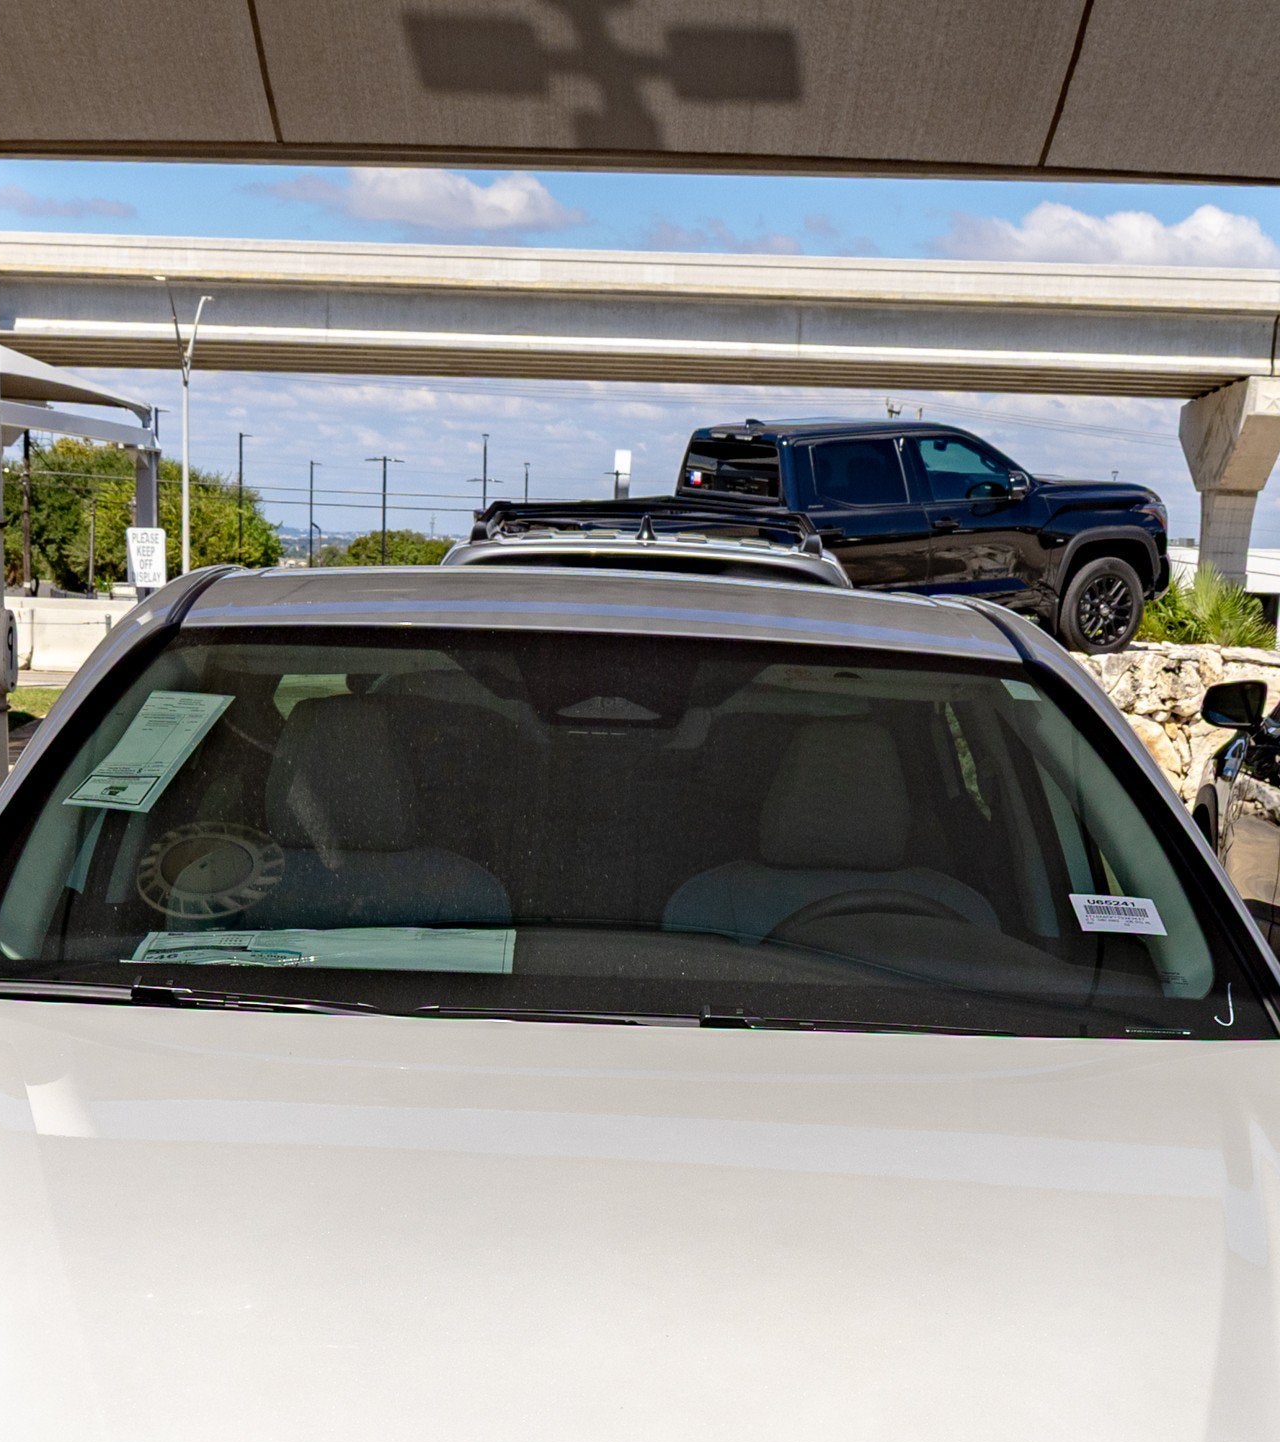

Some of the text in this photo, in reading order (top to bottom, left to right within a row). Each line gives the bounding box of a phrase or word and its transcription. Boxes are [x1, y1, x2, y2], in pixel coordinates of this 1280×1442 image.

[131, 533, 160, 544] PLEASE
[136, 546, 156, 557] KEEP
[139, 559, 153, 570] OFF
[132, 571, 162, 583] DISPLAY
